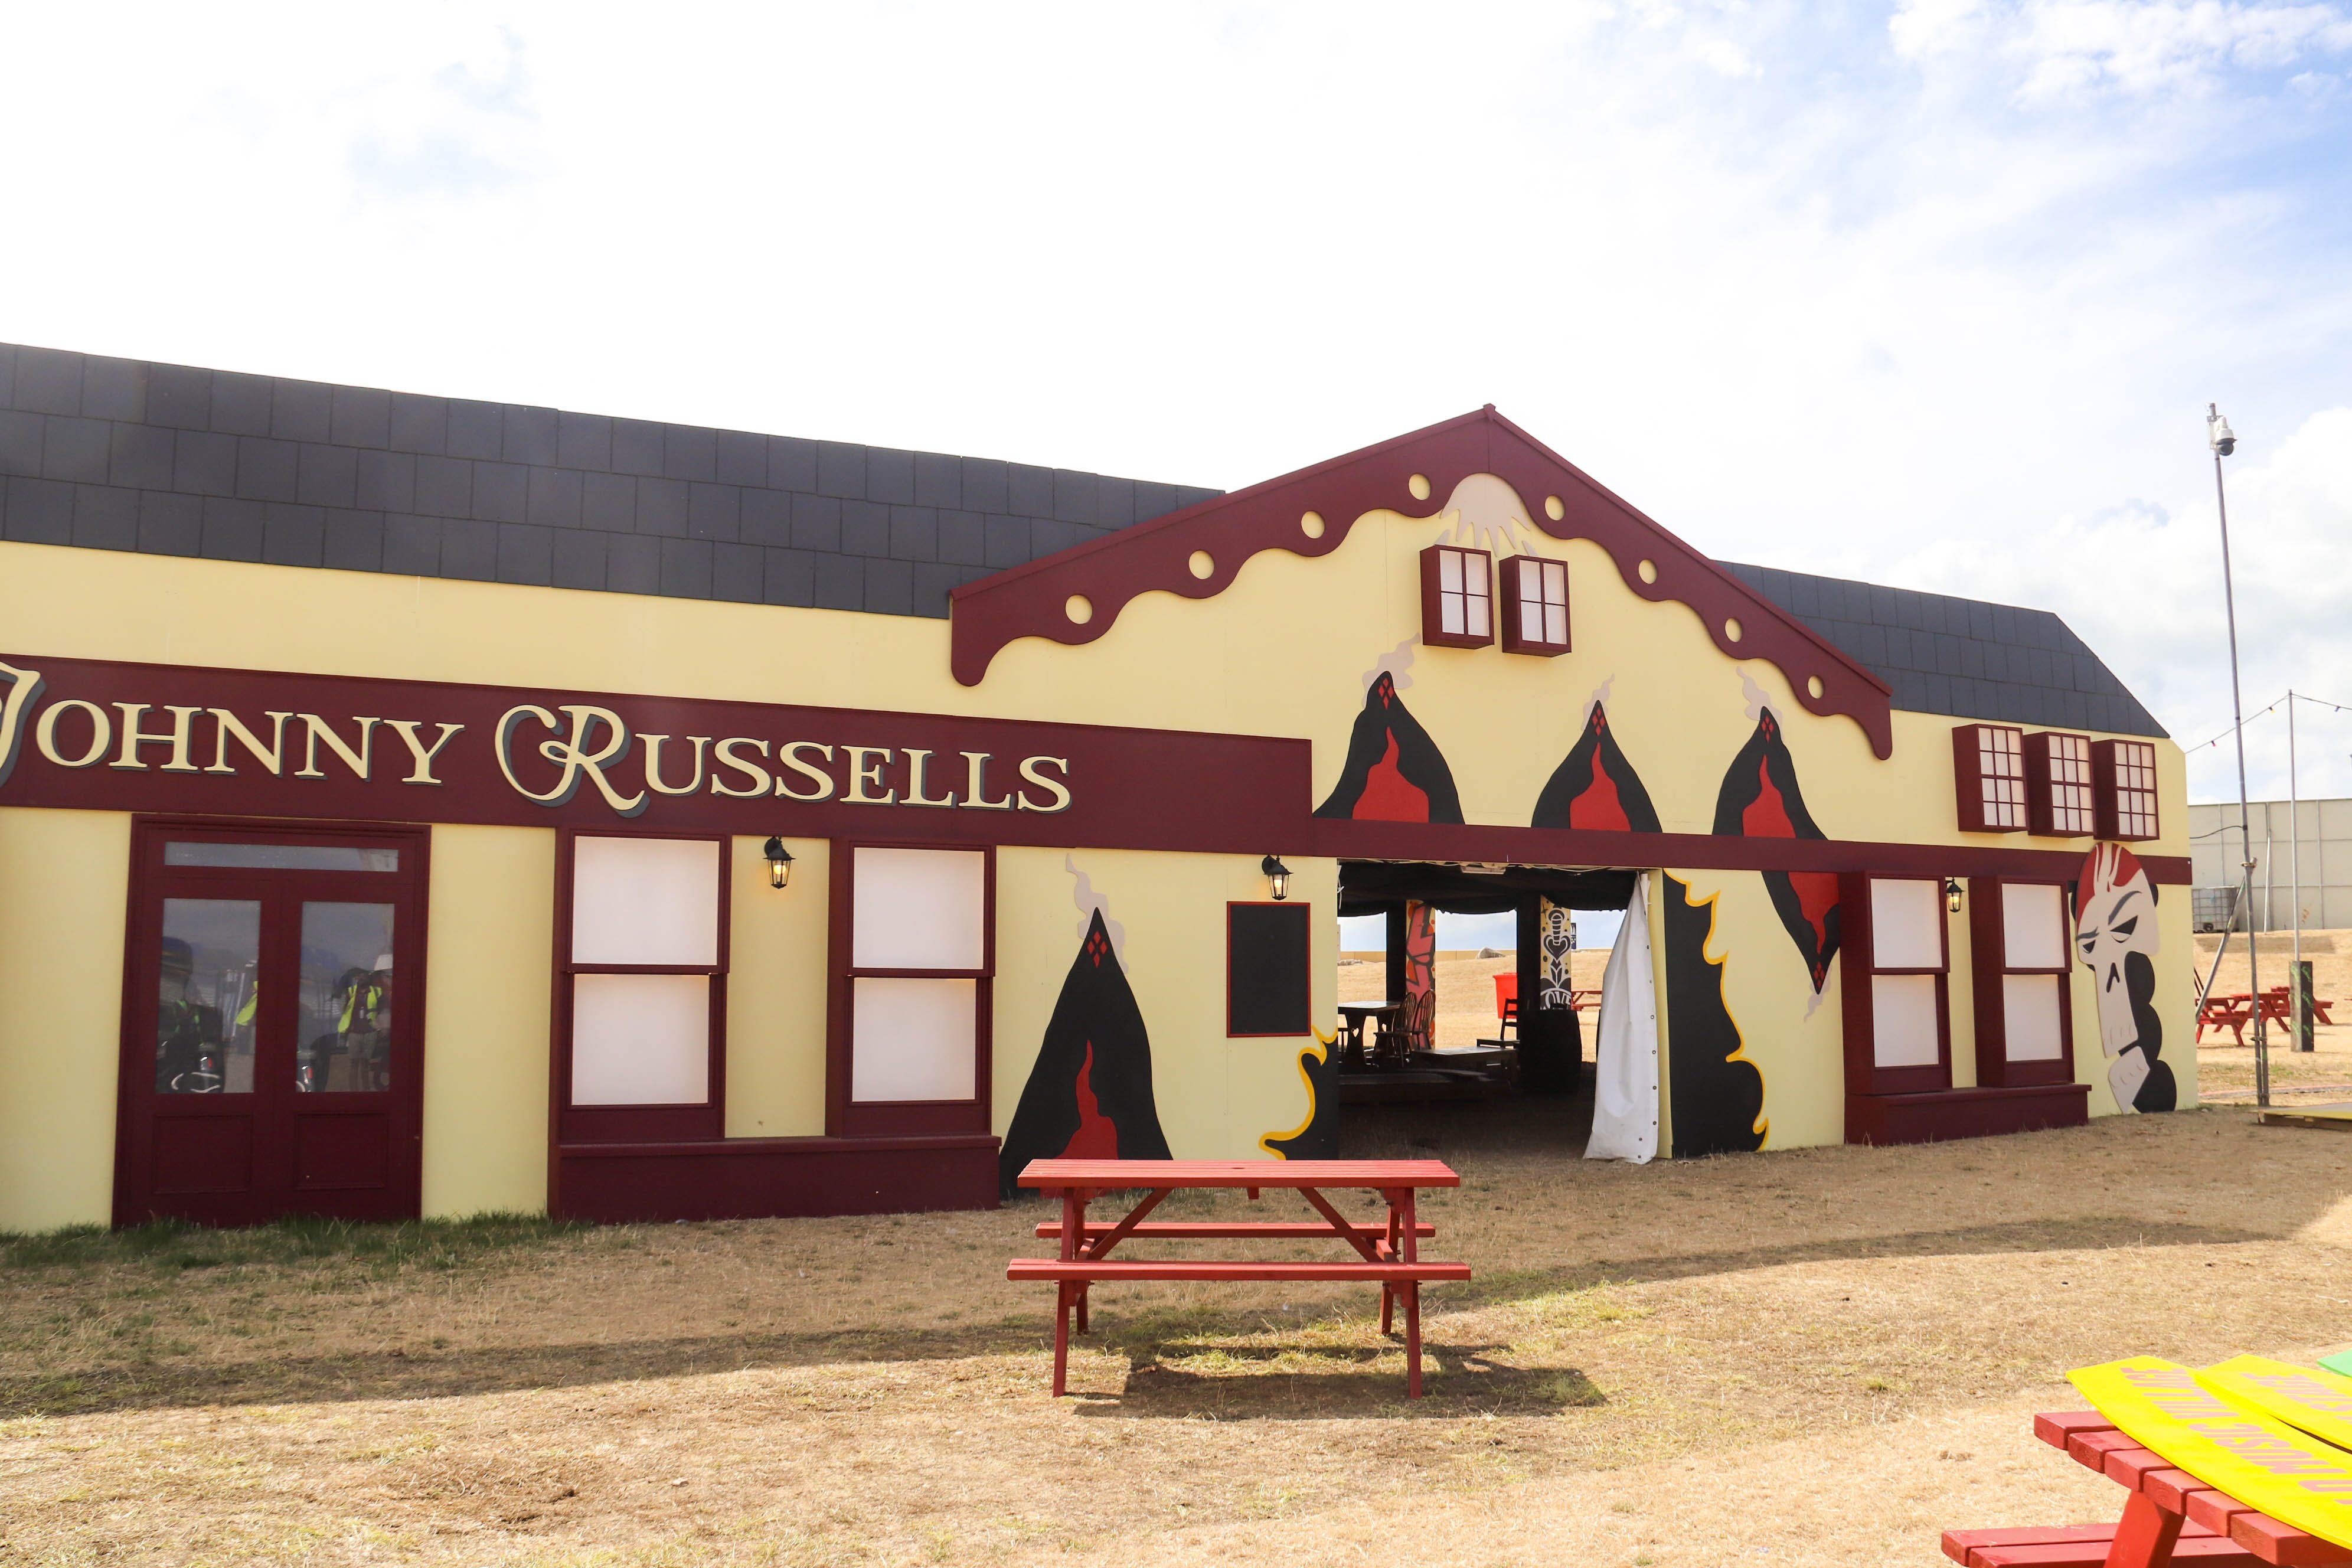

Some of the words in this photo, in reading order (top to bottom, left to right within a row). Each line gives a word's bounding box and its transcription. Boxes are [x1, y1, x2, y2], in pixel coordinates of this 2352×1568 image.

[494, 704, 1071, 816] RUSSELLS
[2120, 1367, 2239, 1419] VILLAGE
[2187, 1423, 2348, 1474] MUSIC
